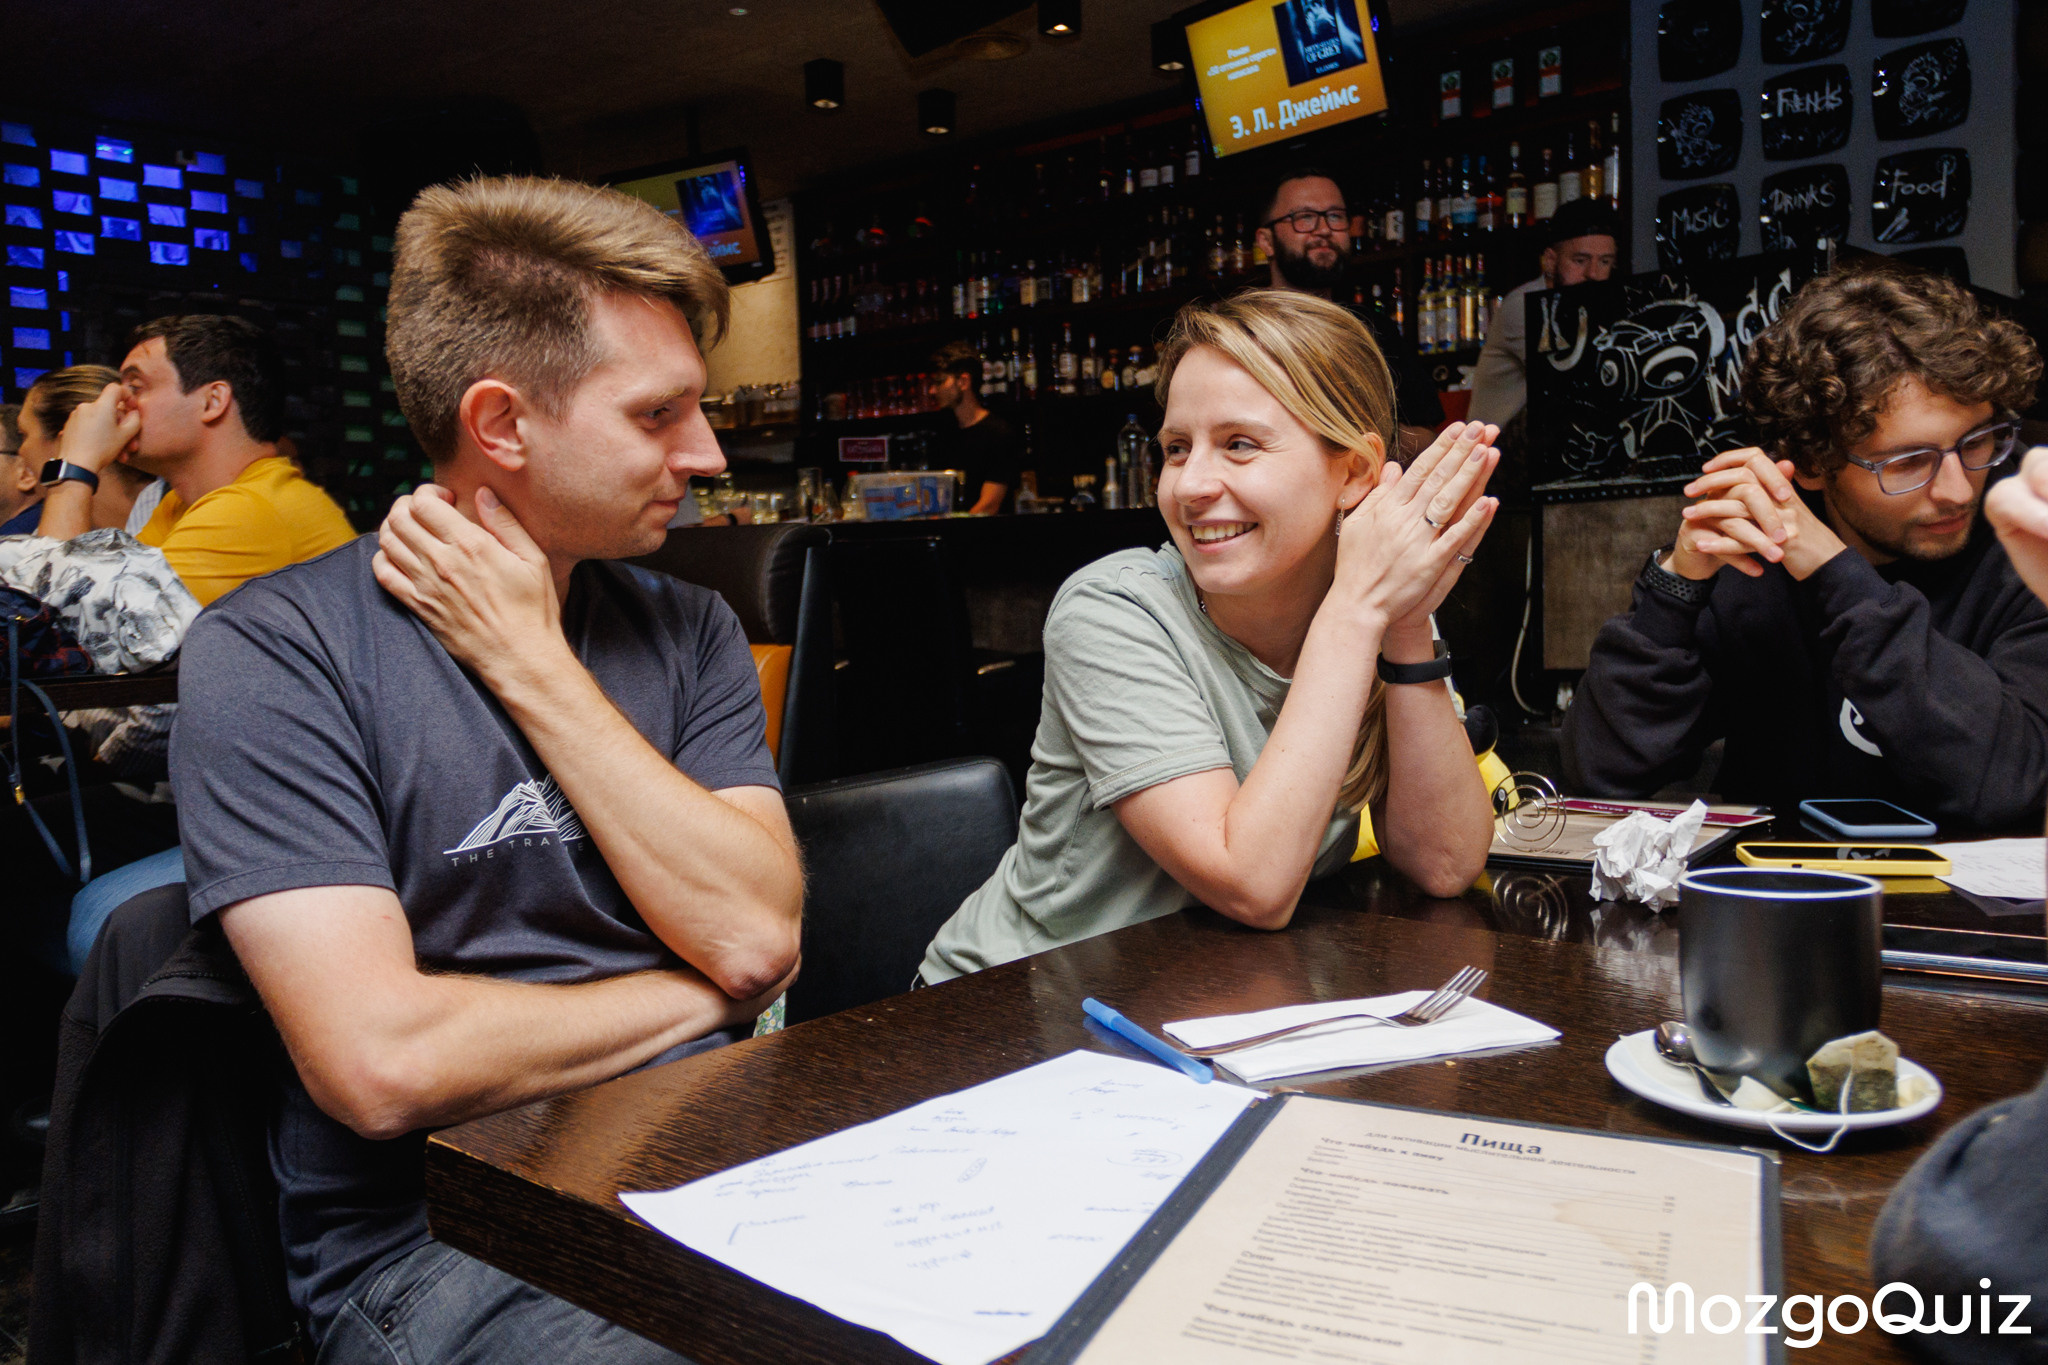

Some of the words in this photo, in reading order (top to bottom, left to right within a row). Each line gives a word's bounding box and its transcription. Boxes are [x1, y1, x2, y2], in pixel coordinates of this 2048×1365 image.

[1229, 115, 1250, 139] Э.
[1253, 106, 1275, 133] Л.
[1277, 84, 1361, 130] Джеймс
[451, 849, 494, 867] THE
[1460, 1133, 1542, 1155] Пища
